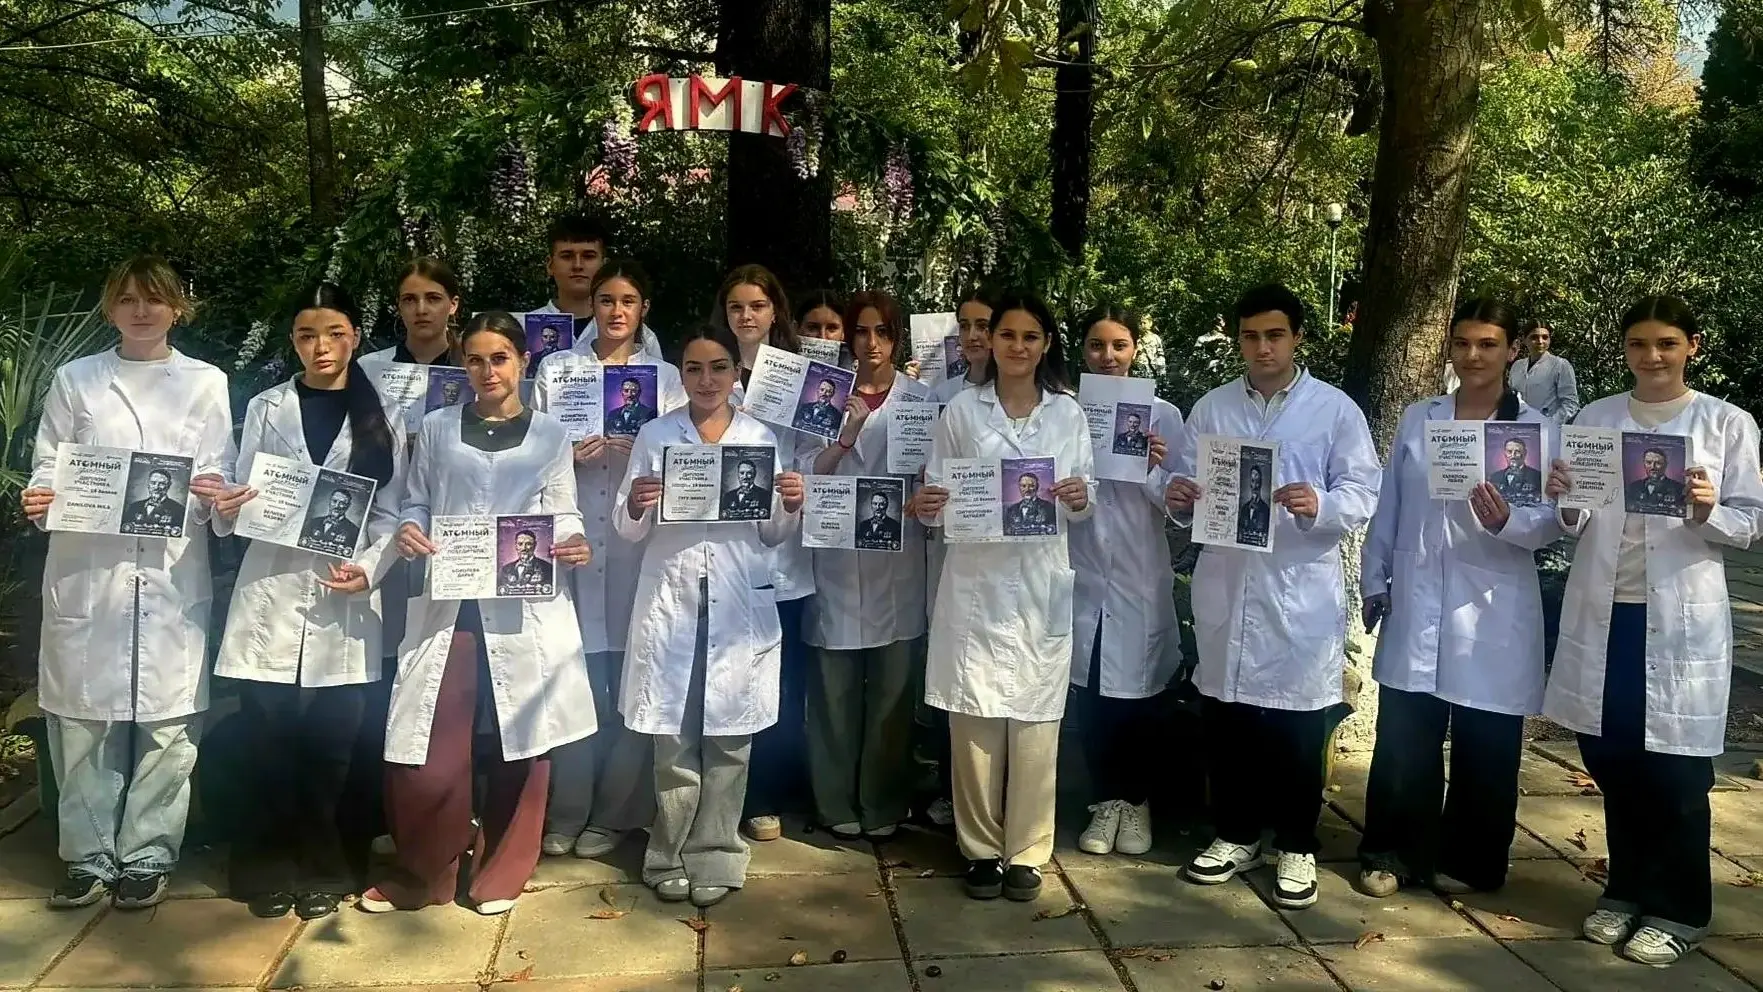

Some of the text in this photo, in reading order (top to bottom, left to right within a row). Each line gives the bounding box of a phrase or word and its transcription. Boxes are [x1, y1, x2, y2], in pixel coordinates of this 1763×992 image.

[636, 74, 799, 138] ЯМК
[764, 360, 802, 374] АТОМНЫЙ
[552, 374, 597, 383] АТОМНЫЙ
[1431, 434, 1477, 443] АТОМНЫЙ
[1566, 440, 1614, 452] АТОМНЫЙ
[69, 459, 122, 470] АТОМНЫЙ
[673, 456, 715, 465] АТОМНЫЙ
[263, 469, 309, 485] АТОМНЫЙ
[951, 470, 995, 480] АТОМНЫЙ
[812, 487, 850, 495] АТОМНЫЙ
[443, 528, 489, 537] АТОМНЫЙ
